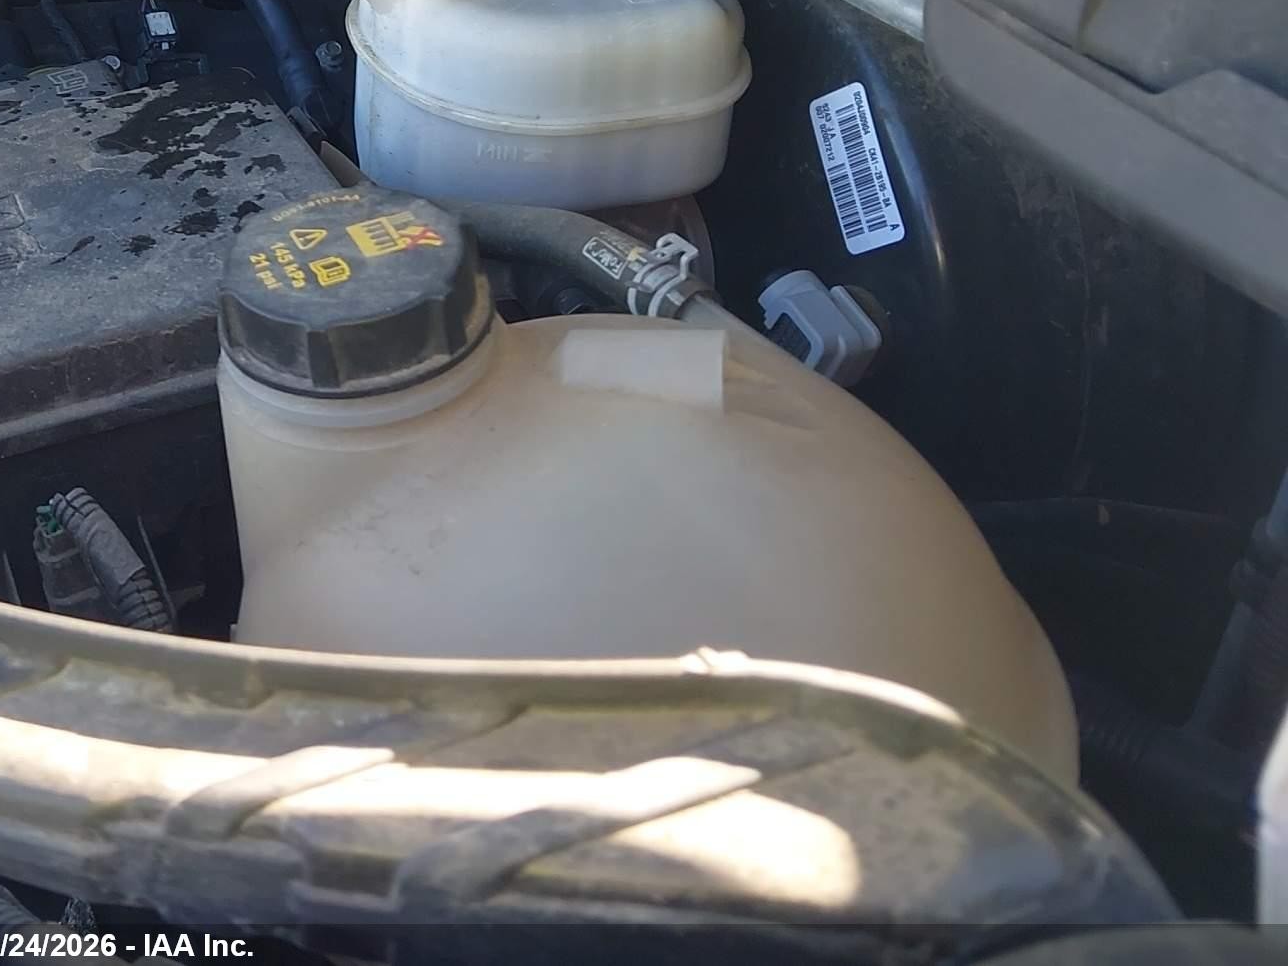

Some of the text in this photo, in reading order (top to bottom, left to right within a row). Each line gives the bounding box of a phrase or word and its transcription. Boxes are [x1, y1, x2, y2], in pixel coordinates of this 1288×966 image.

[889, 221, 900, 231] A
[270, 242, 294, 263] 145
[249, 253, 283, 290] 21 psi
